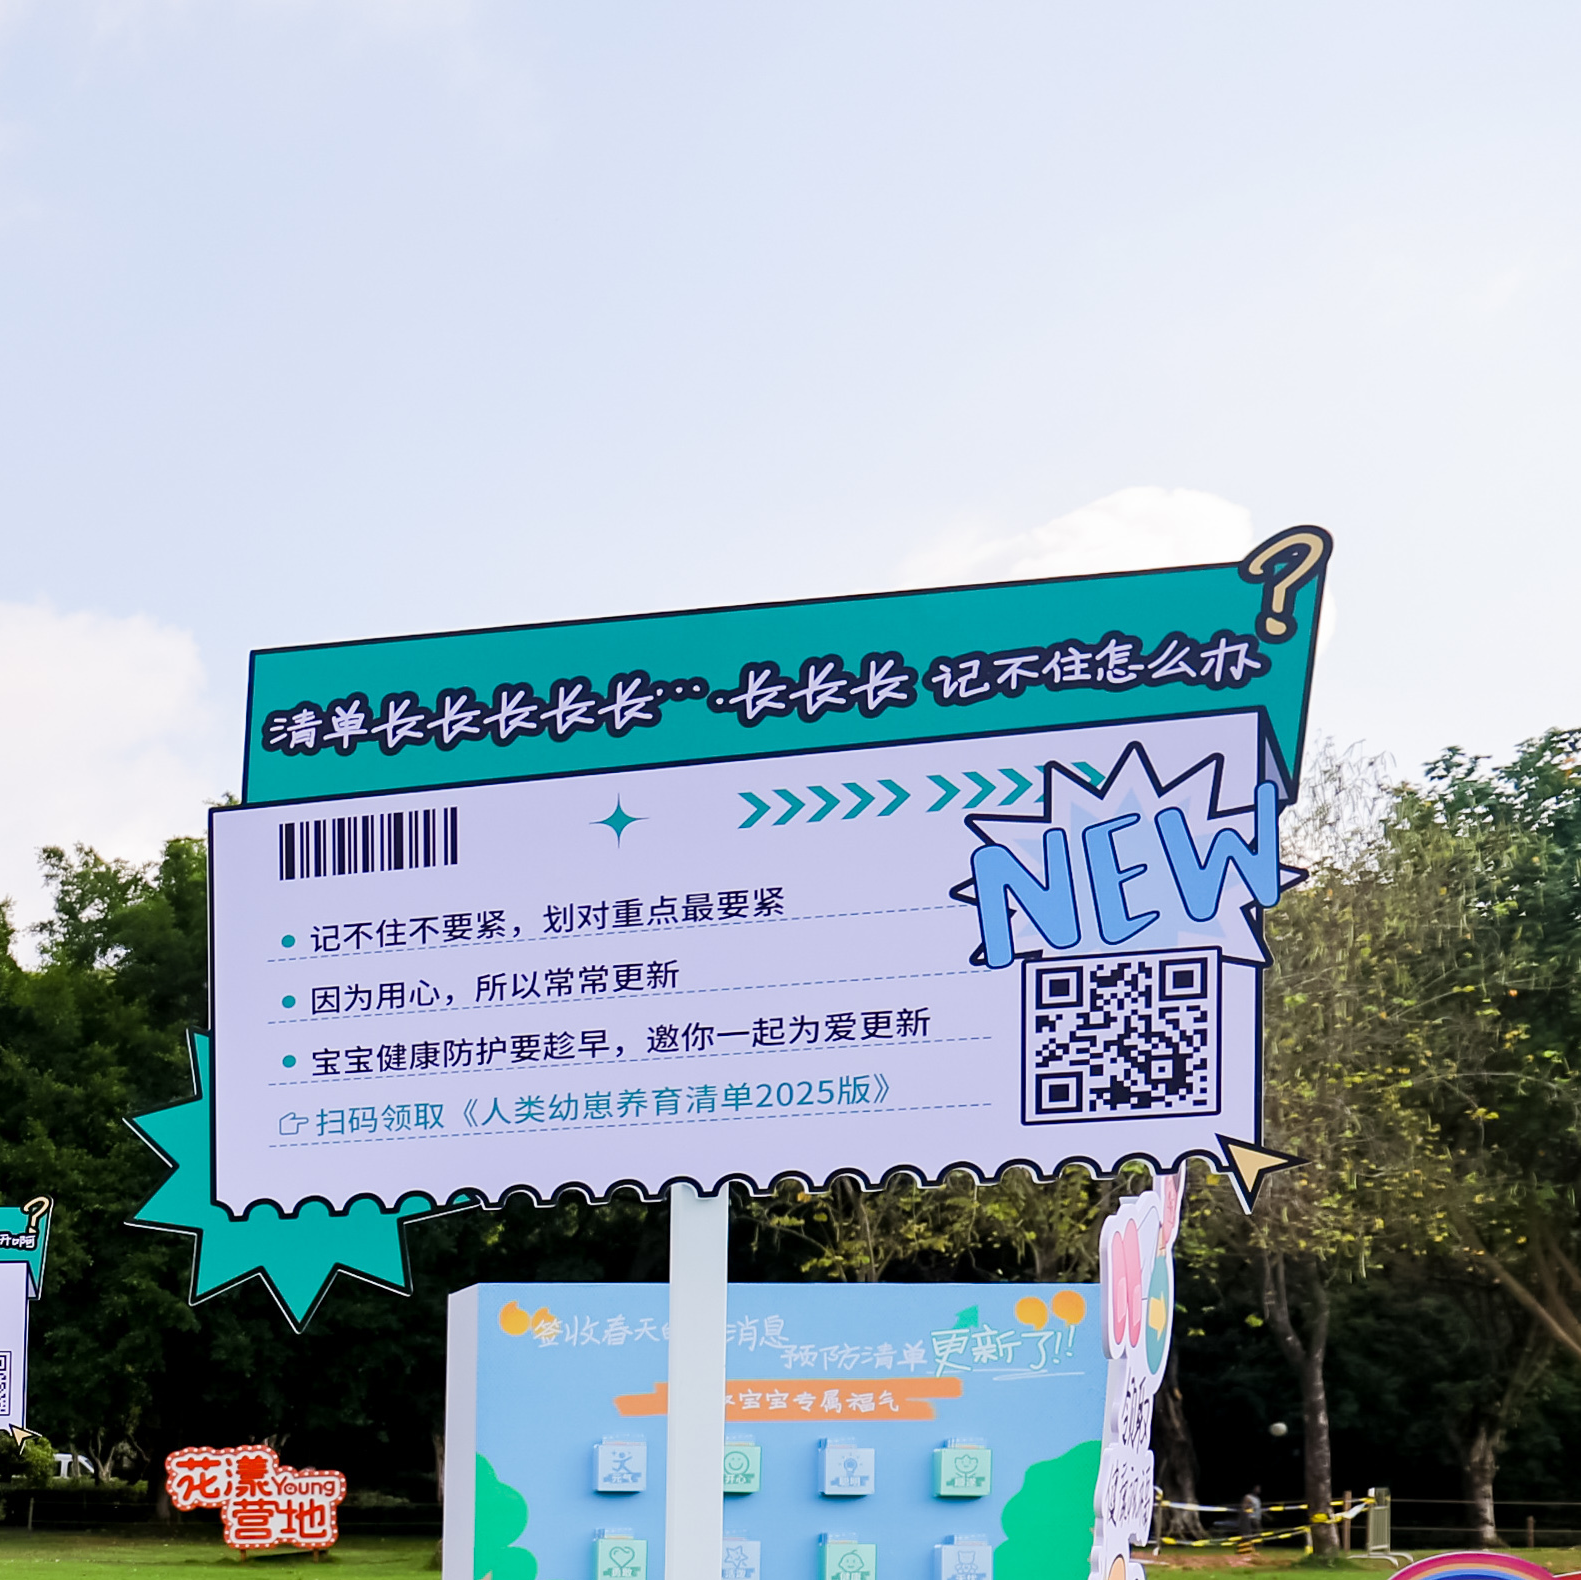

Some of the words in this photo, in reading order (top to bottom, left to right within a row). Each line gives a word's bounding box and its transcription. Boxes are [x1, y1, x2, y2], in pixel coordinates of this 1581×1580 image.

[976, 781, 1280, 967] NEW
[310, 888, 786, 956] 记不住不要紧，划对重点最要紧
[310, 960, 679, 1017] 因为用心，所以常常更新
[311, 1009, 931, 1079] 宝宝健康防护要趁早，邀你一起为爱更新
[316, 1072, 899, 1137] 扫码领取《人类幼崽养育清单2025版》
[233, 1499, 327, 1539] 营地
